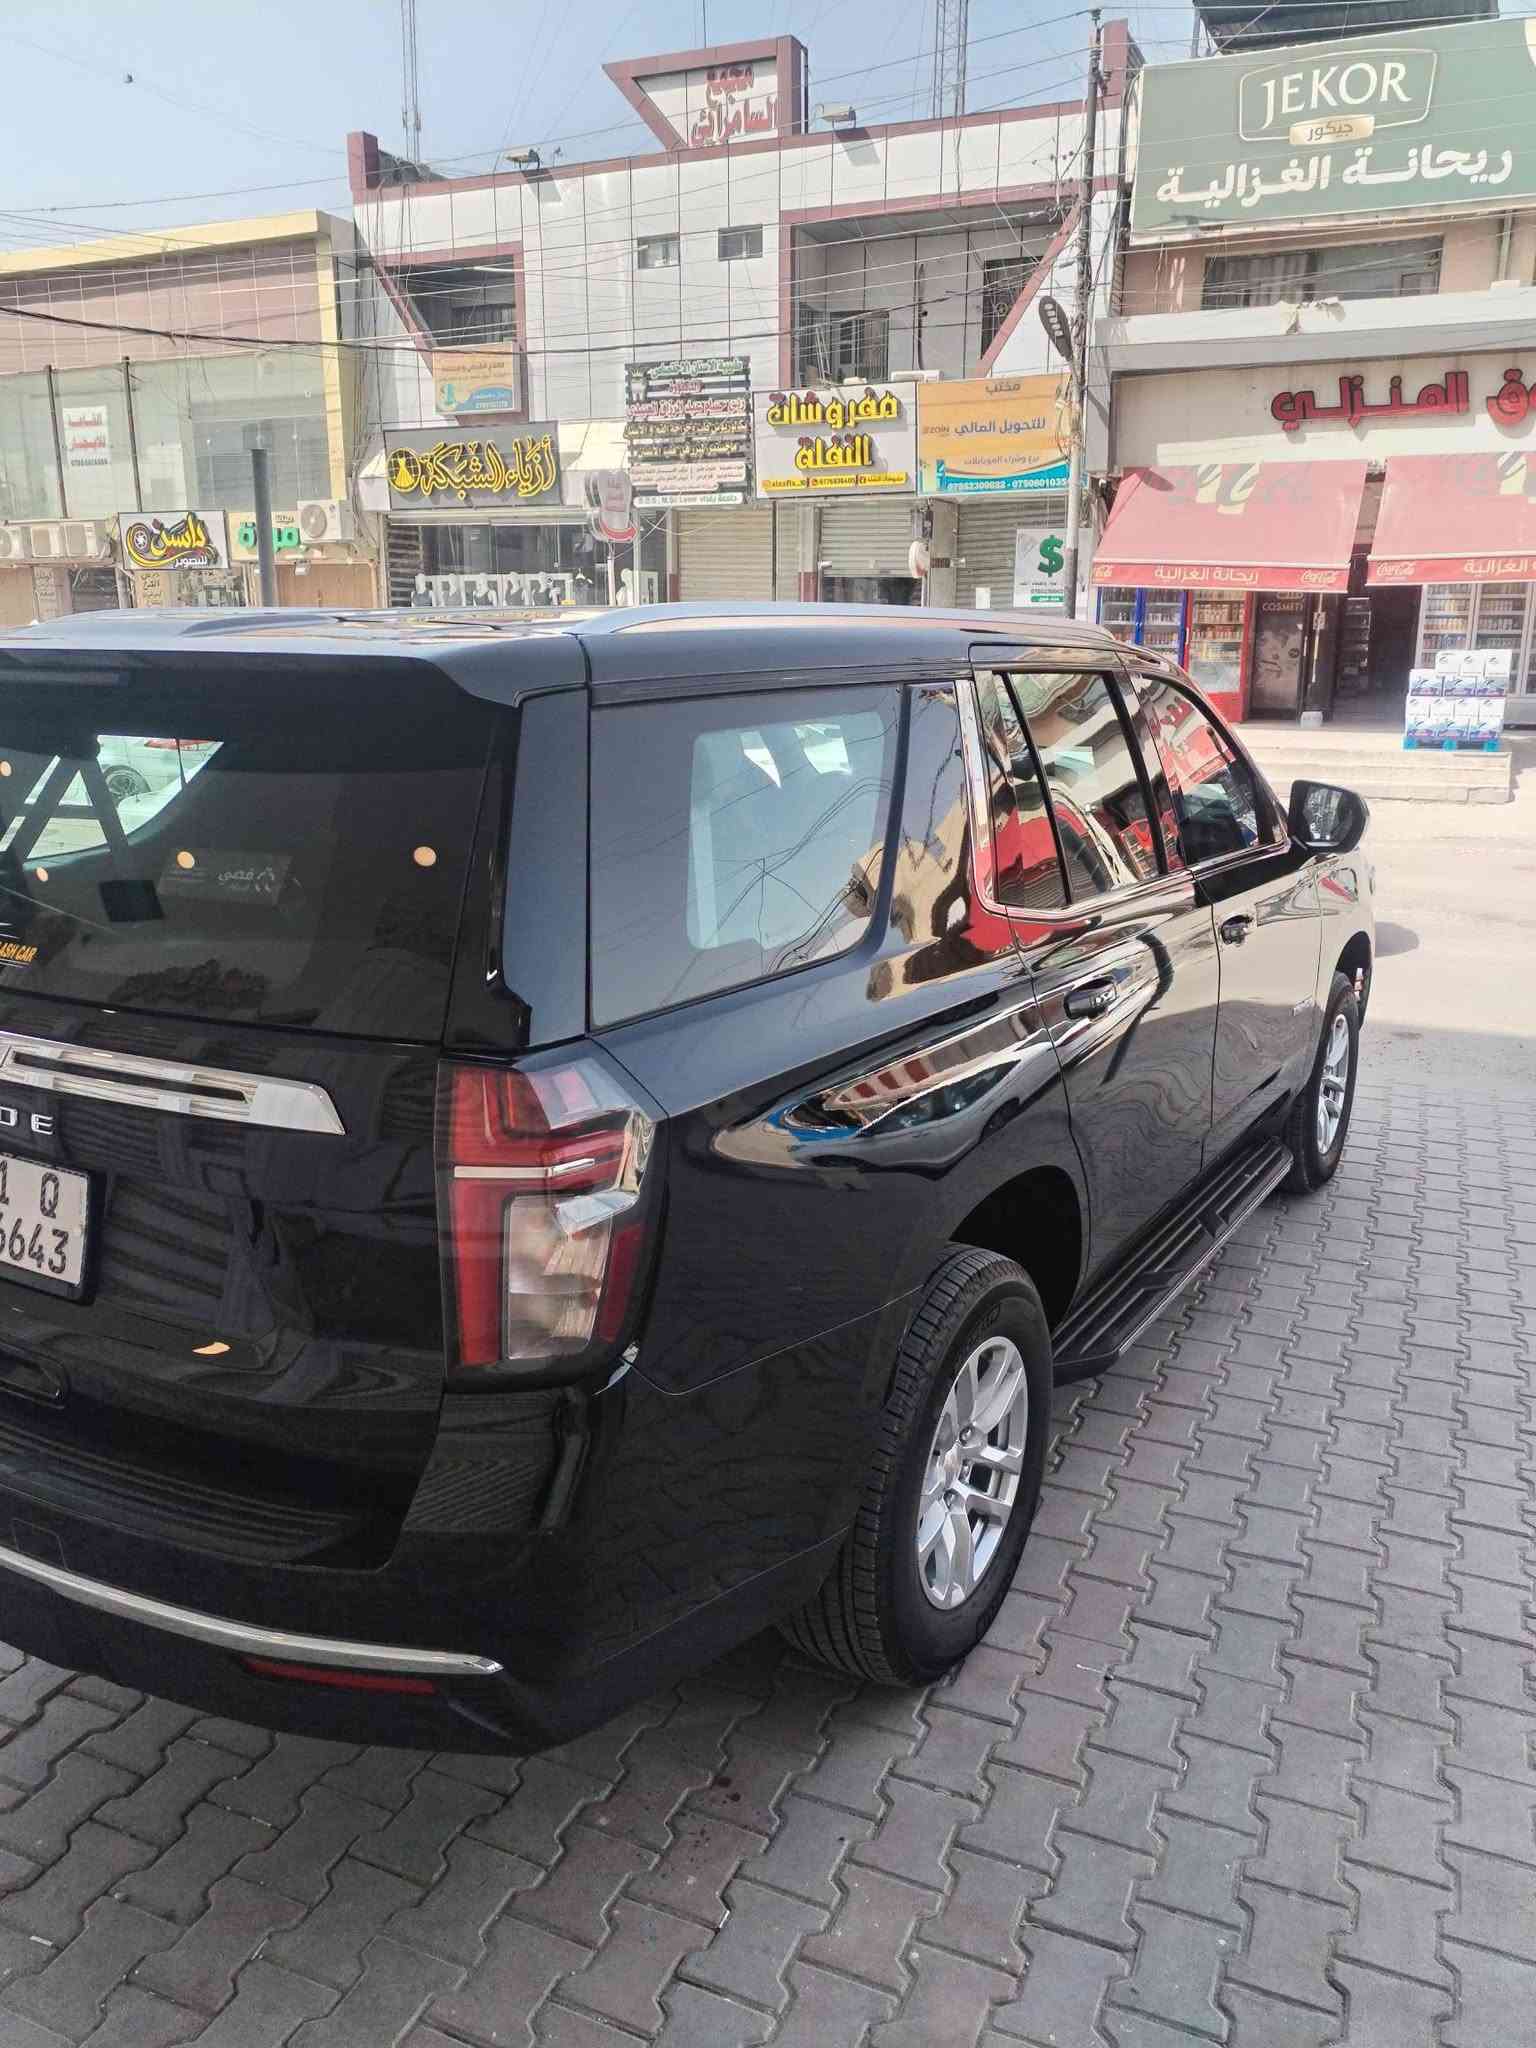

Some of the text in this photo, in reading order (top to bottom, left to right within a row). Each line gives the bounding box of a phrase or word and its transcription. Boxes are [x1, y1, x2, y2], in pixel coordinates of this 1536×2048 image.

[1260, 61, 1412, 130] JEKOR
[1303, 120, 1354, 142] جيكور
[1156, 144, 1513, 208] ريحانة الغزالية
[767, 387, 898, 430] مفروشات
[985, 381, 1021, 396] مكتب
[1270, 370, 1469, 431] المنزلي
[954, 416, 1046, 437] للتحويل المالي
[420, 439, 505, 501] الشبكة
[504, 433, 556, 497] أزياء
[39, 1171, 60, 1219] Q
